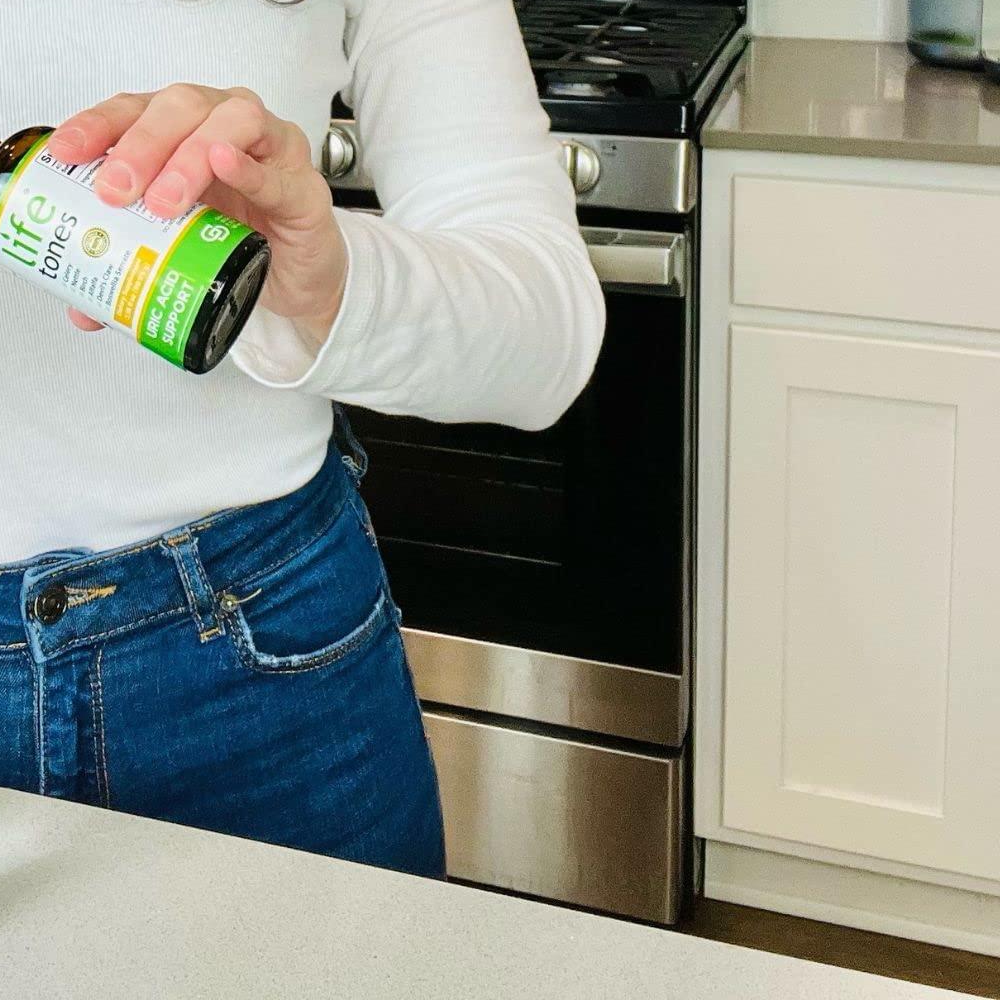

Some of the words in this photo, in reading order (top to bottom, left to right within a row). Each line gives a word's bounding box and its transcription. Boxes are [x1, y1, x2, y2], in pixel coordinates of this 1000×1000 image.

[0, 195, 56, 267] life
[39, 212, 77, 279] tones
[145, 307, 164, 339] URIC
[156, 268, 181, 309] ACID
[161, 279, 194, 346] SUPPORT
